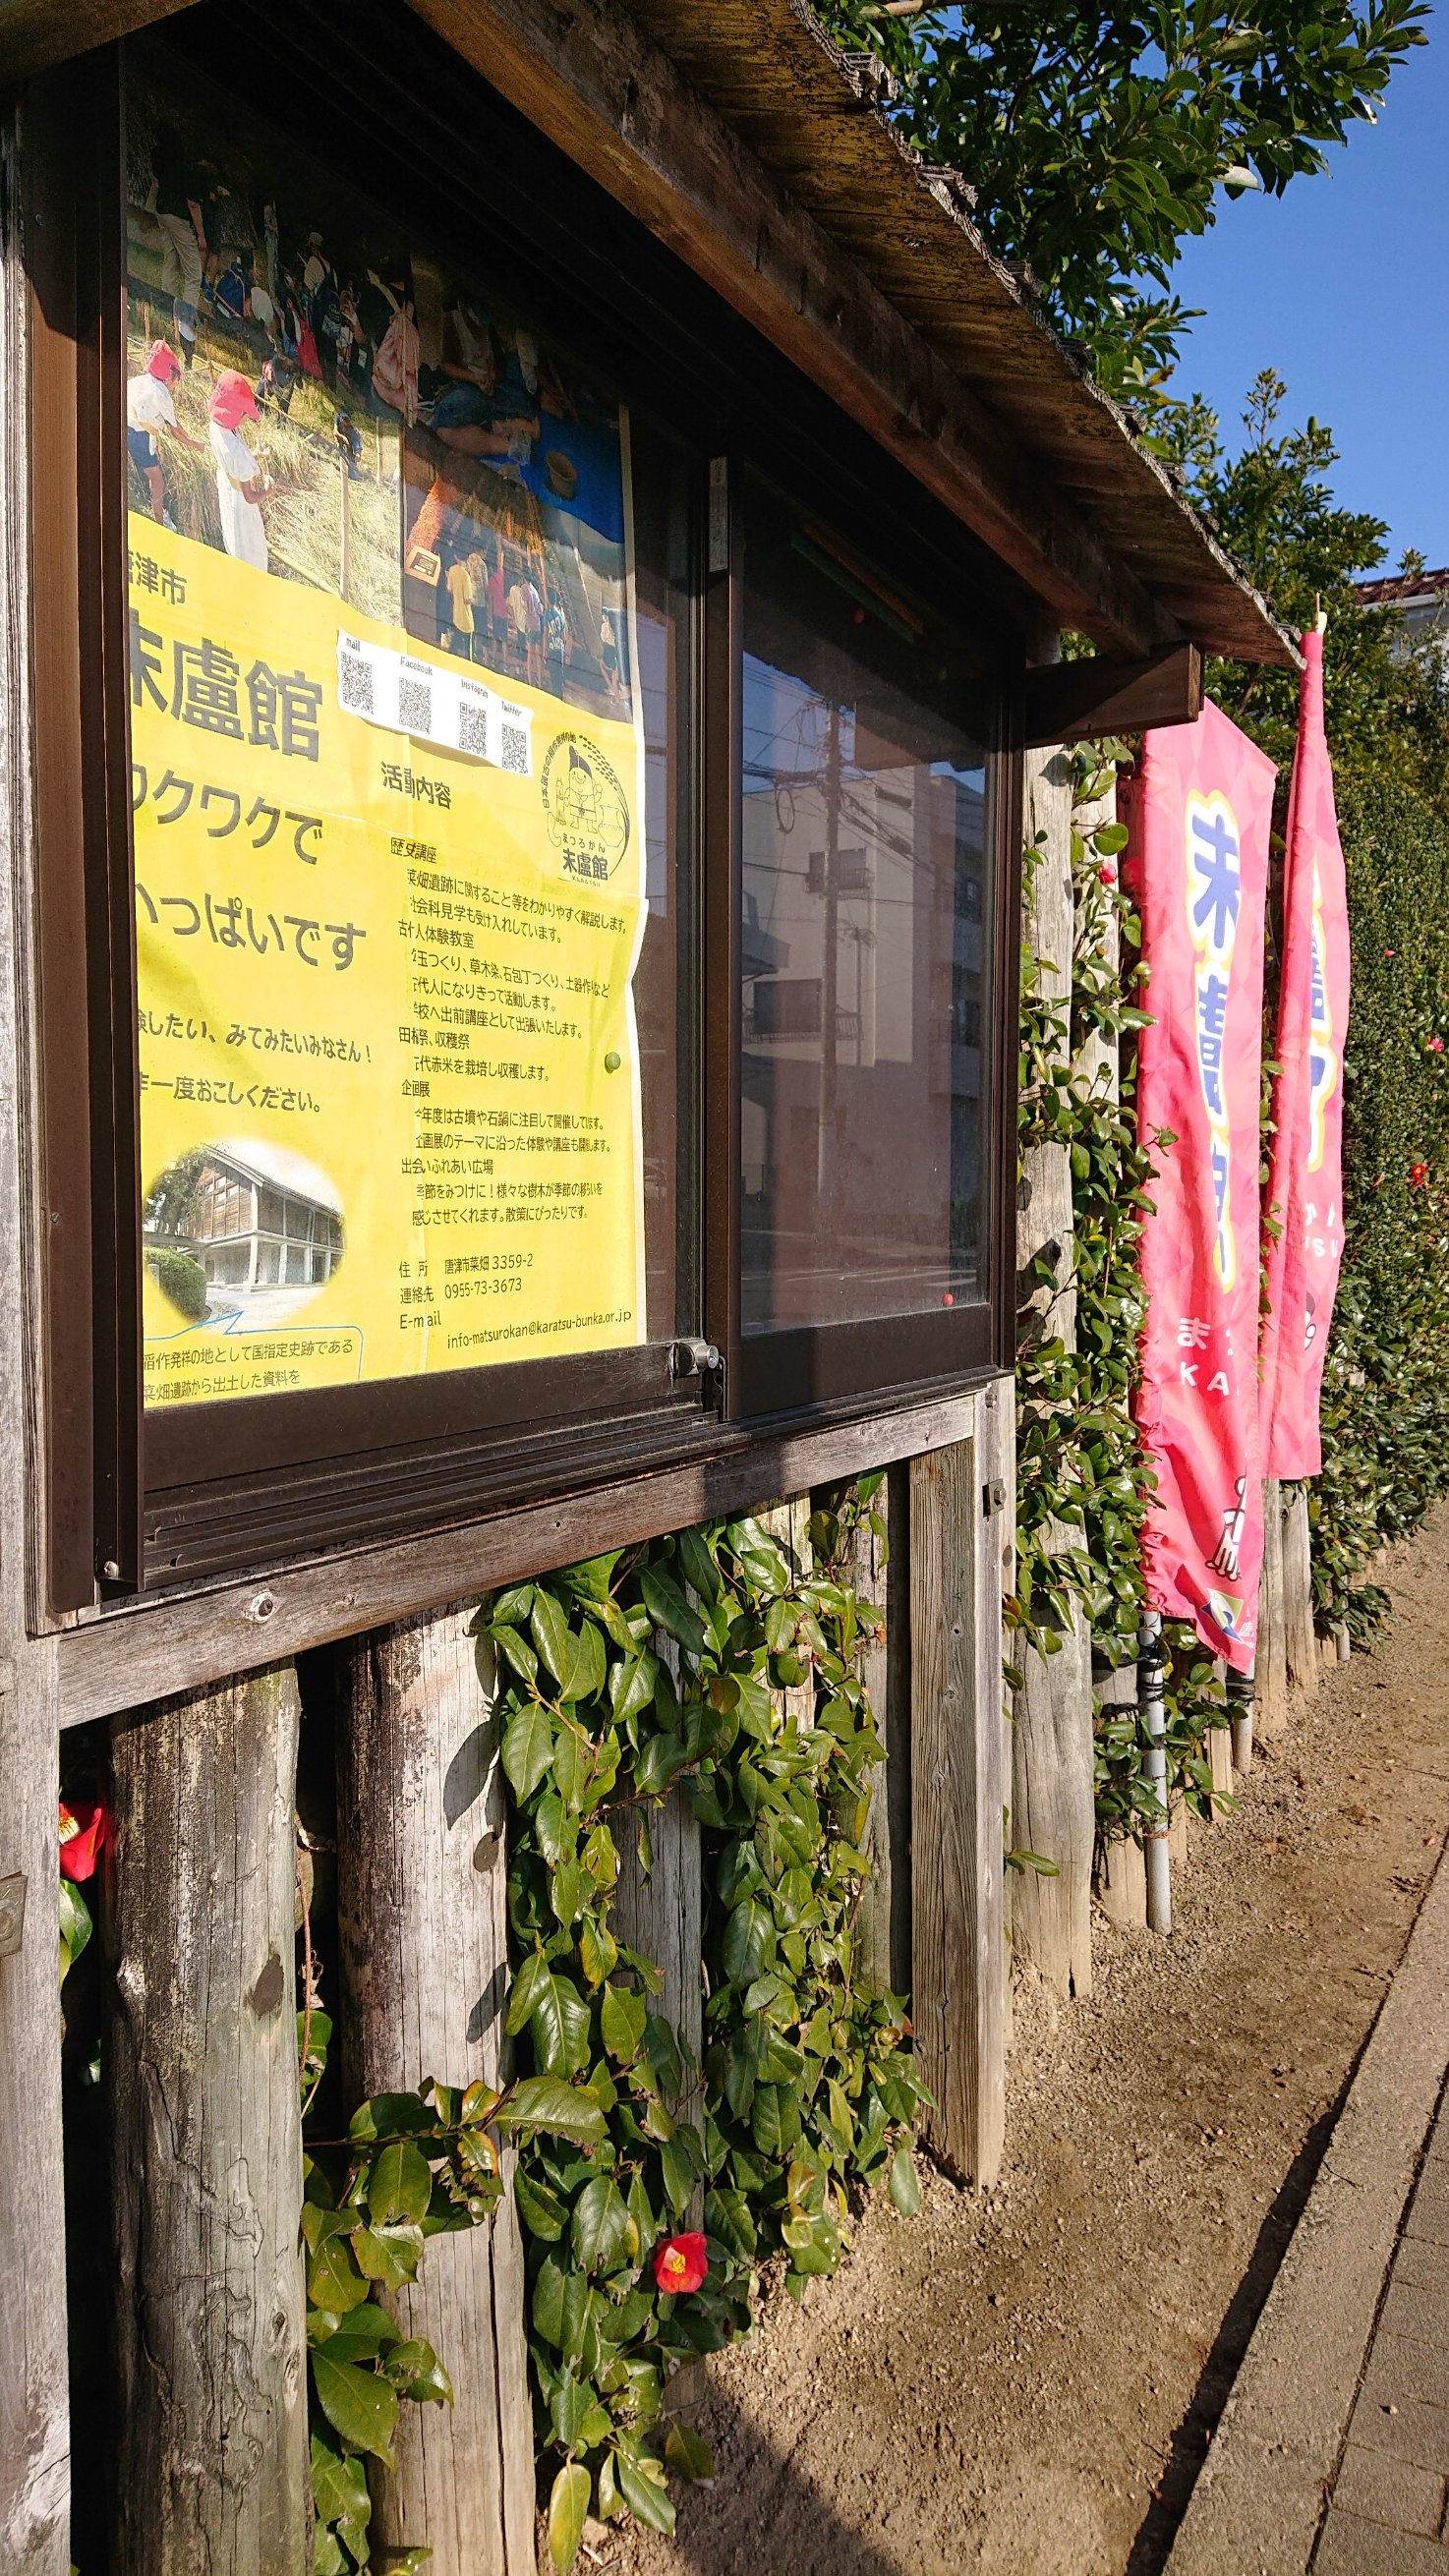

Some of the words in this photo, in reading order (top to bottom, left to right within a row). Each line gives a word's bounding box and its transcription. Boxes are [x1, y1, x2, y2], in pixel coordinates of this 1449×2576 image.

[346, 638, 361, 653] mail
[400, 657, 433, 676] Facebook
[501, 701, 522, 717] Twitter
[391, 837, 436, 864] 歴史講座
[563, 833, 606, 853] まつろかん
[563, 848, 608, 882] 末盧館
[401, 1079, 430, 1098] 企画展
[401, 1158, 493, 1174] 出会いふれあい広場
[399, 1260, 411, 1278] 住
[444, 1255, 490, 1275] 唐津市菜畑
[492, 1253, 534, 1270] 3359-2
[400, 1287, 435, 1304] 連絡先
[444, 1278, 522, 1299] 0955-73-3673
[399, 1310, 441, 1329] E-mail
[447, 1309, 632, 1349] info-matsurokan@karatsu-bunka.or.jp
[1180, 1361, 1240, 1397] KA
